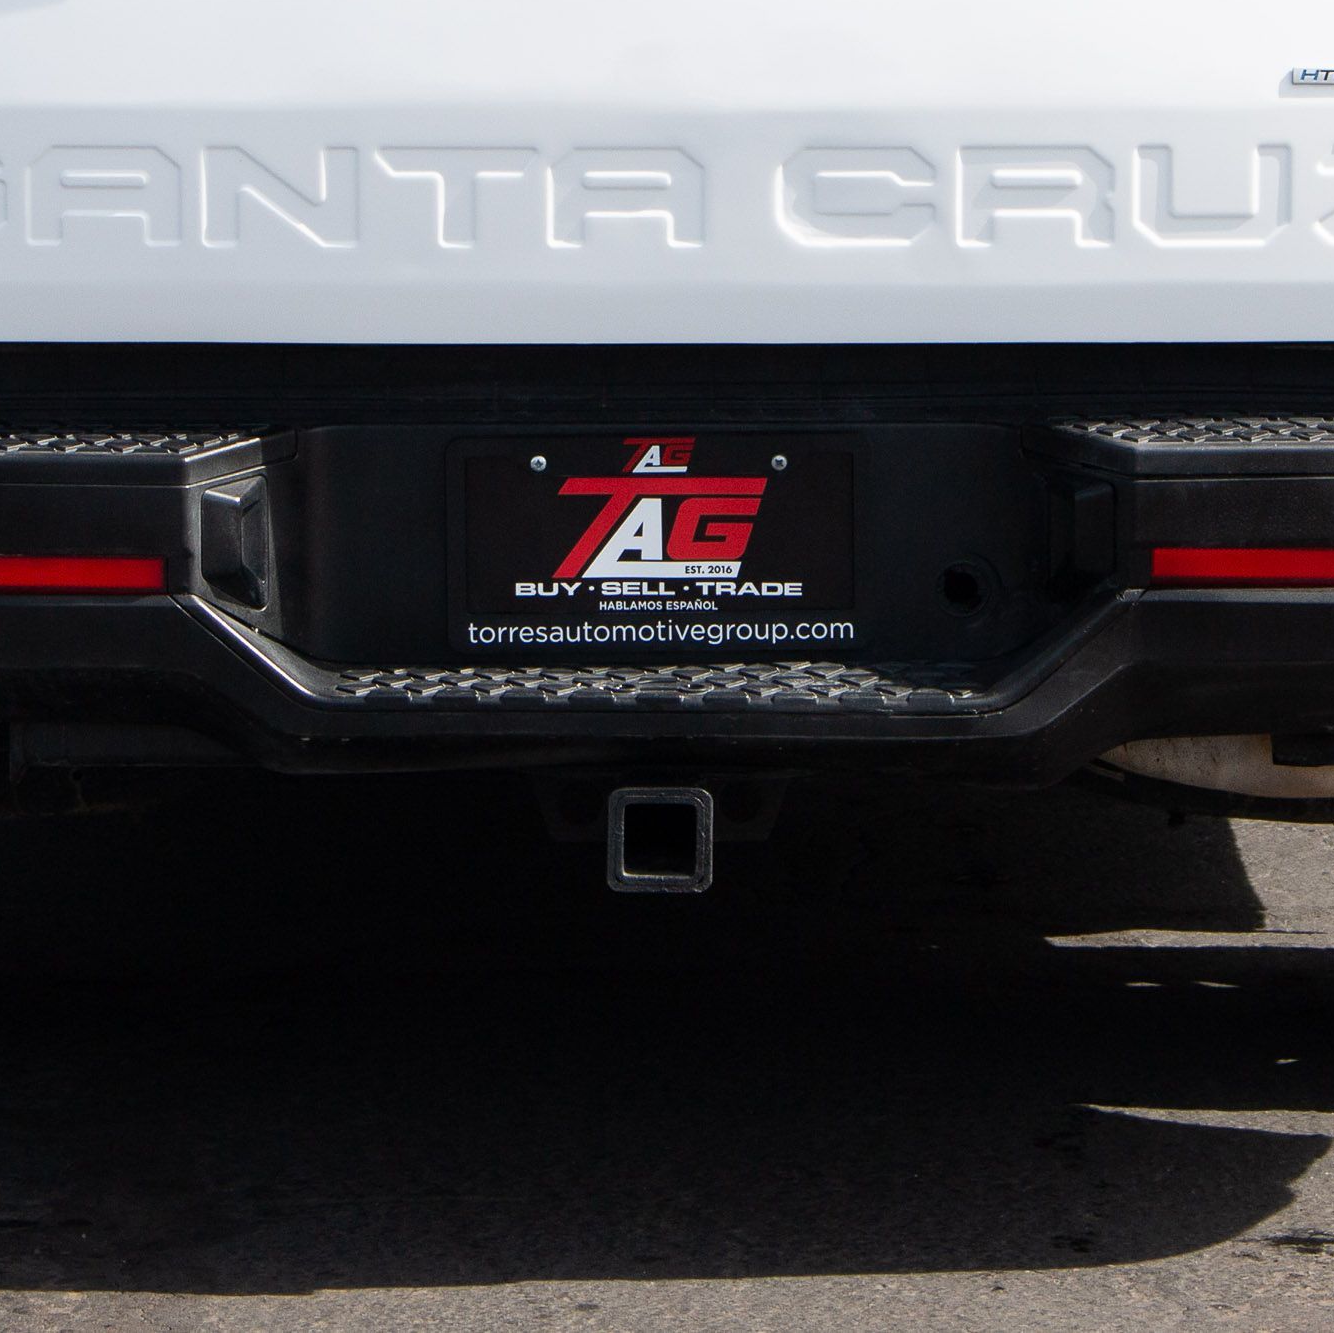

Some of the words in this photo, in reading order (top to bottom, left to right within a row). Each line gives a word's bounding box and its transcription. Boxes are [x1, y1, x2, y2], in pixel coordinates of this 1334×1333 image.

[622, 437, 696, 473] TAG
[551, 477, 768, 579] TAG
[684, 565, 706, 574] EST.
[708, 565, 733, 574] 2016
[514, 581, 583, 597] BUY
[600, 581, 676, 597] SELL
[695, 581, 803, 597] TRADE
[598, 600, 664, 612] HABLAMOS
[665, 598, 719, 611] ESPAÑOL
[467, 618, 855, 646] torresautomotivegroup.com
